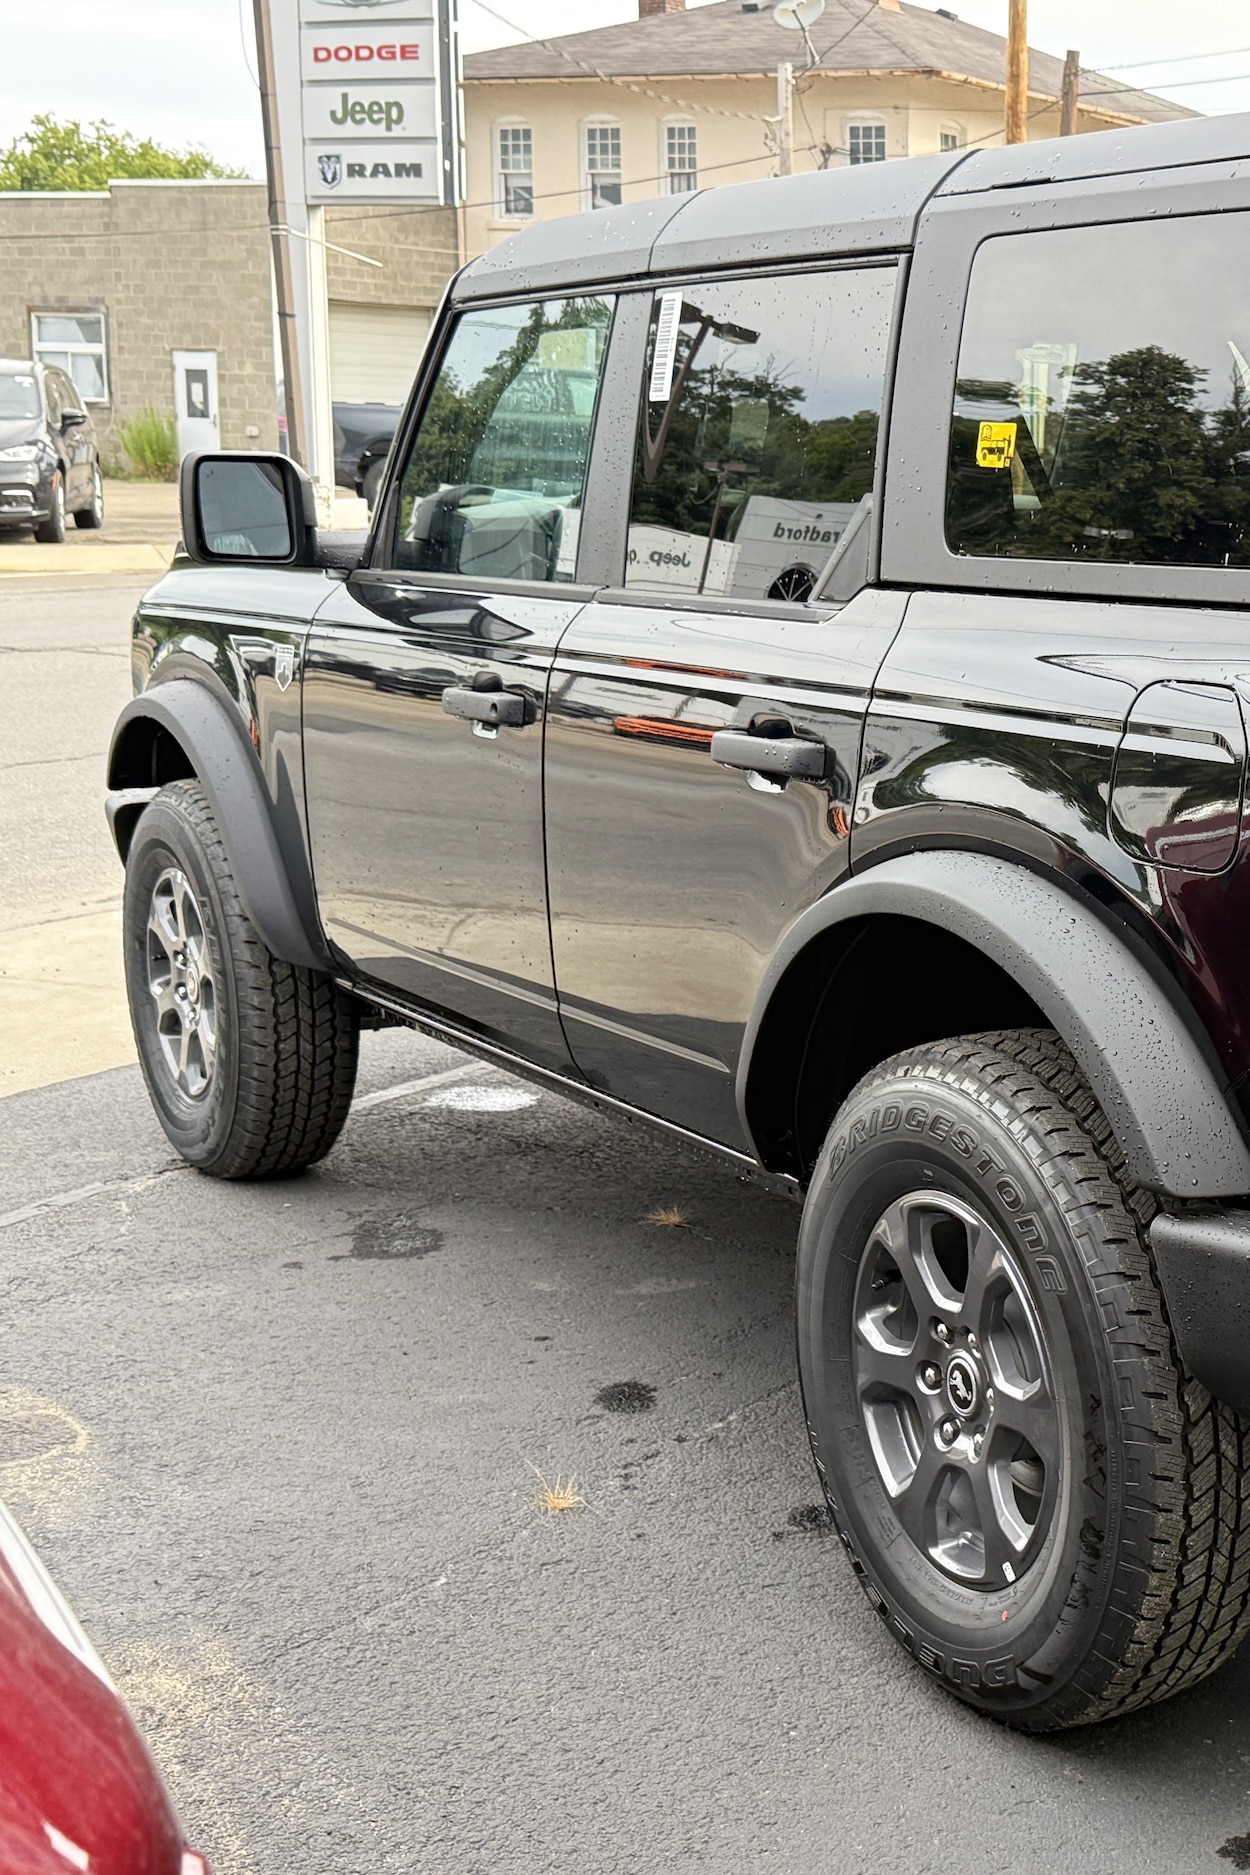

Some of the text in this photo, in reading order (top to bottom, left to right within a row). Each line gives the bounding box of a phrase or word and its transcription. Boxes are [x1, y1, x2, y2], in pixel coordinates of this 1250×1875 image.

[313, 44, 420, 63] DODGE
[329, 92, 404, 132] Jeep
[346, 162, 423, 179] RAM
[828, 1098, 1069, 1296] BRIDGESTONE
